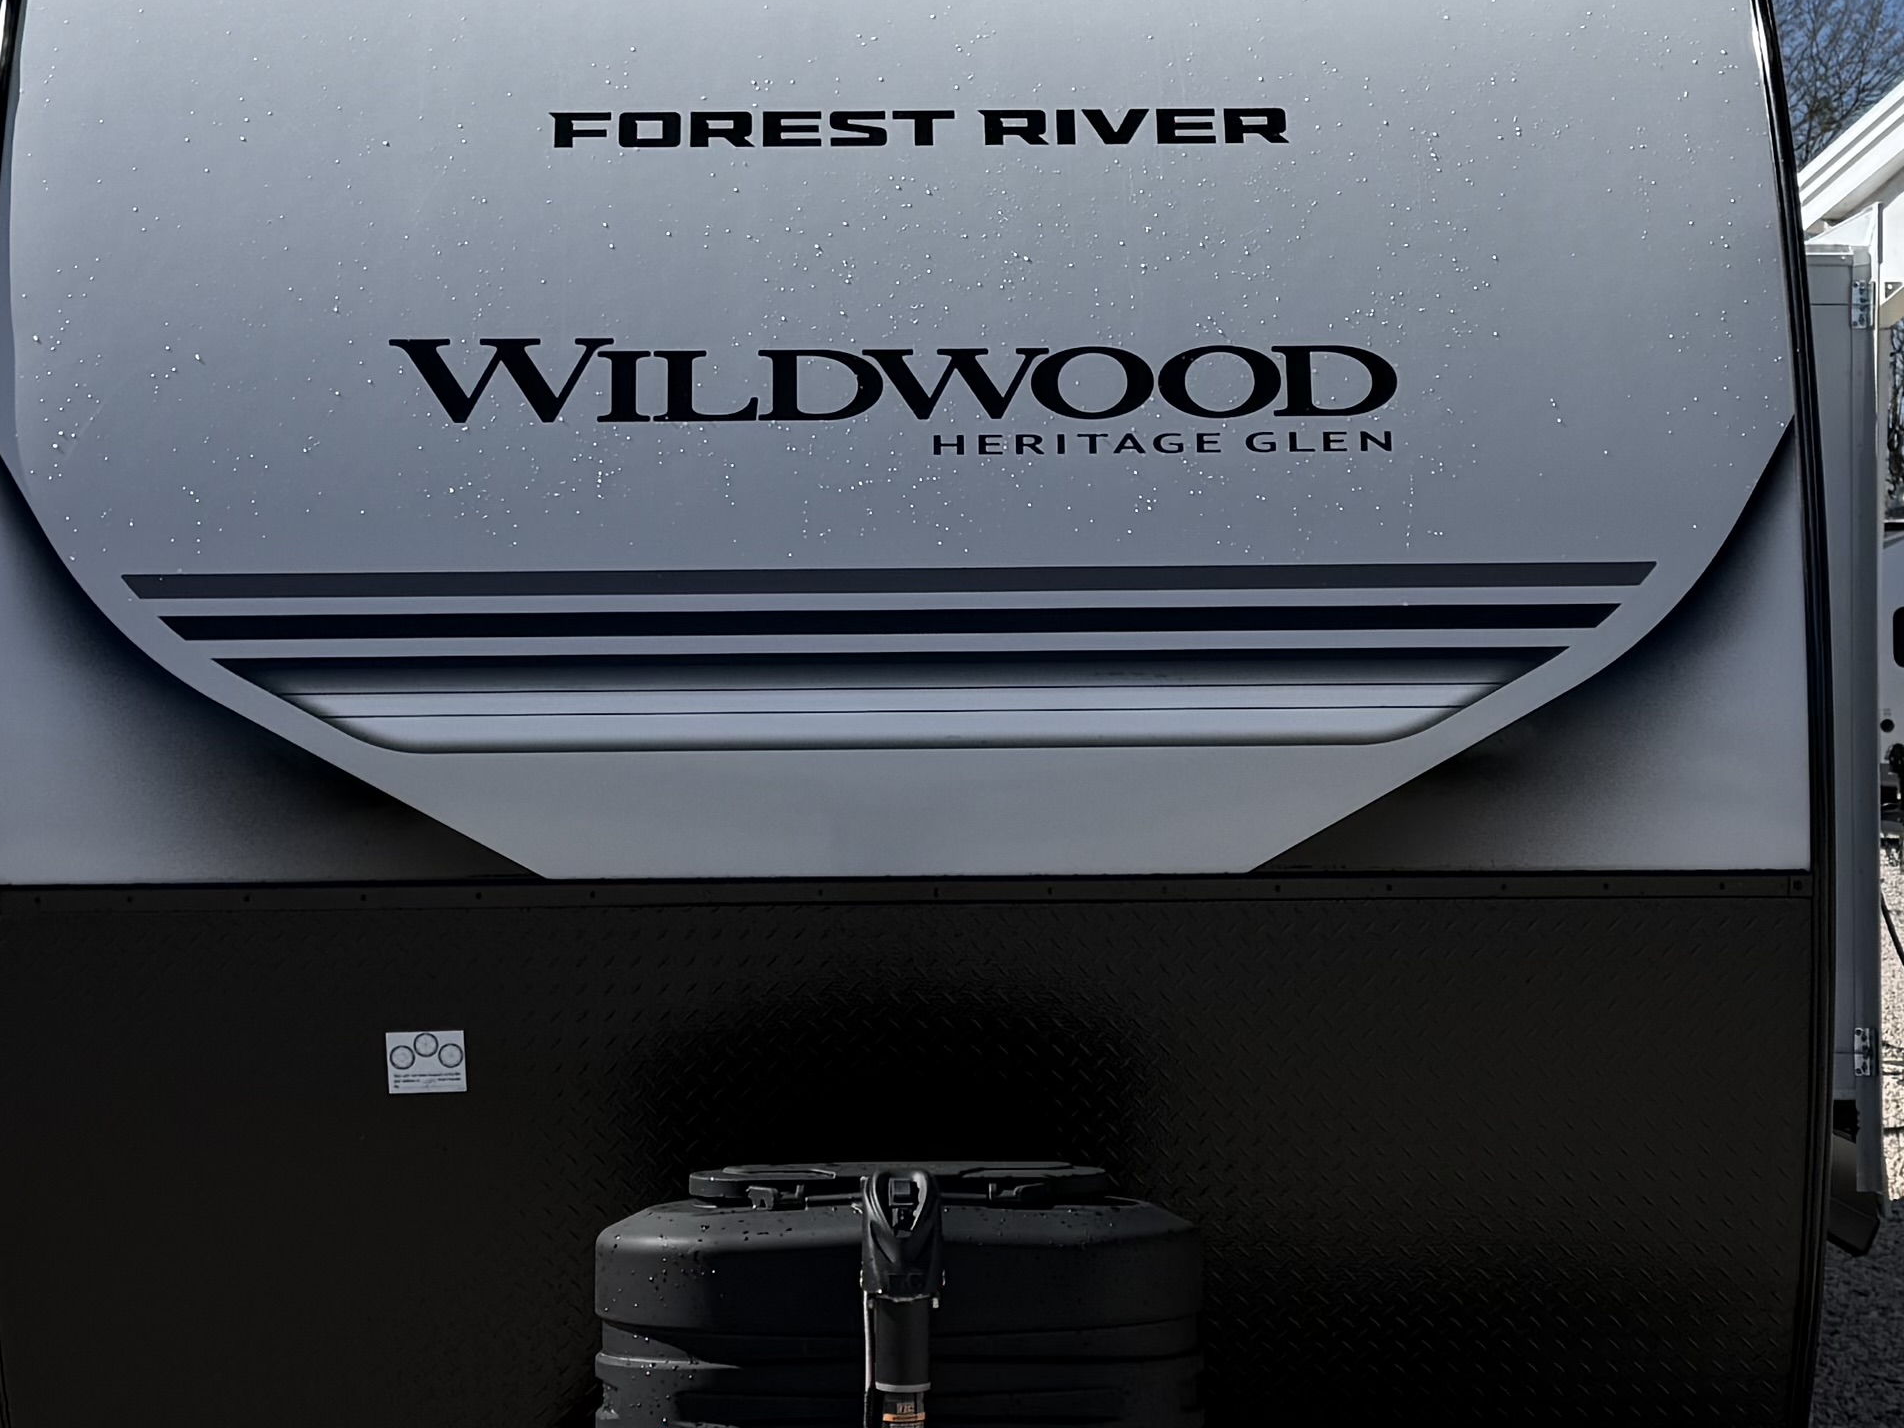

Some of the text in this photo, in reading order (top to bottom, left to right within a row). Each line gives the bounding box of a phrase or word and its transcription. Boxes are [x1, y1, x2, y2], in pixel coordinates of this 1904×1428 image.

[548, 107, 1291, 149] FOREST RIVER
[388, 337, 1399, 424] WILDWOOD
[932, 430, 1394, 456] HERITAGE GLEN
